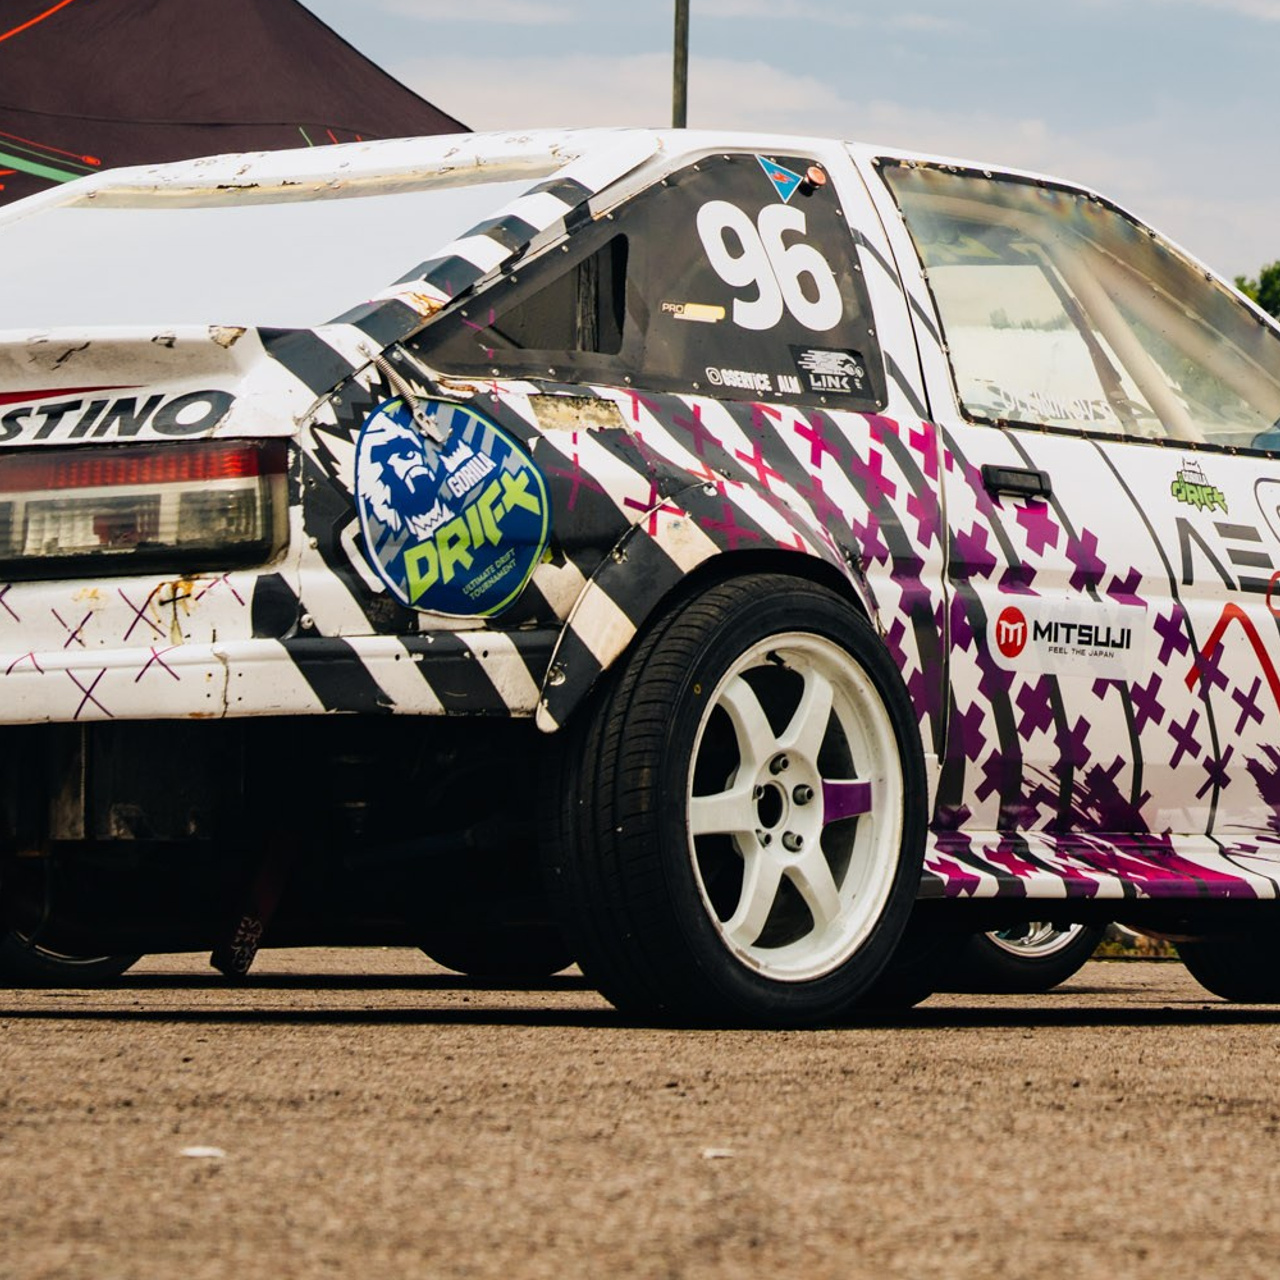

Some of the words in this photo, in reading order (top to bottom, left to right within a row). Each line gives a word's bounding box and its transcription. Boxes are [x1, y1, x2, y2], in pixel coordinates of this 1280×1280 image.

[696, 200, 843, 331] 96
[661, 302, 684, 314] PRO
[0, 390, 236, 442] STINO
[447, 451, 497, 498] GORILLA
[462, 563, 496, 595] ULTIMATE
[493, 548, 516, 570] DRIFT
[469, 560, 517, 600] TOURNAMENT
[1033, 620, 1131, 649] MITSUJI
[1048, 646, 1068, 655] FEEL
[1071, 648, 1085, 656] THE
[1089, 650, 1114, 658] JAPAN
